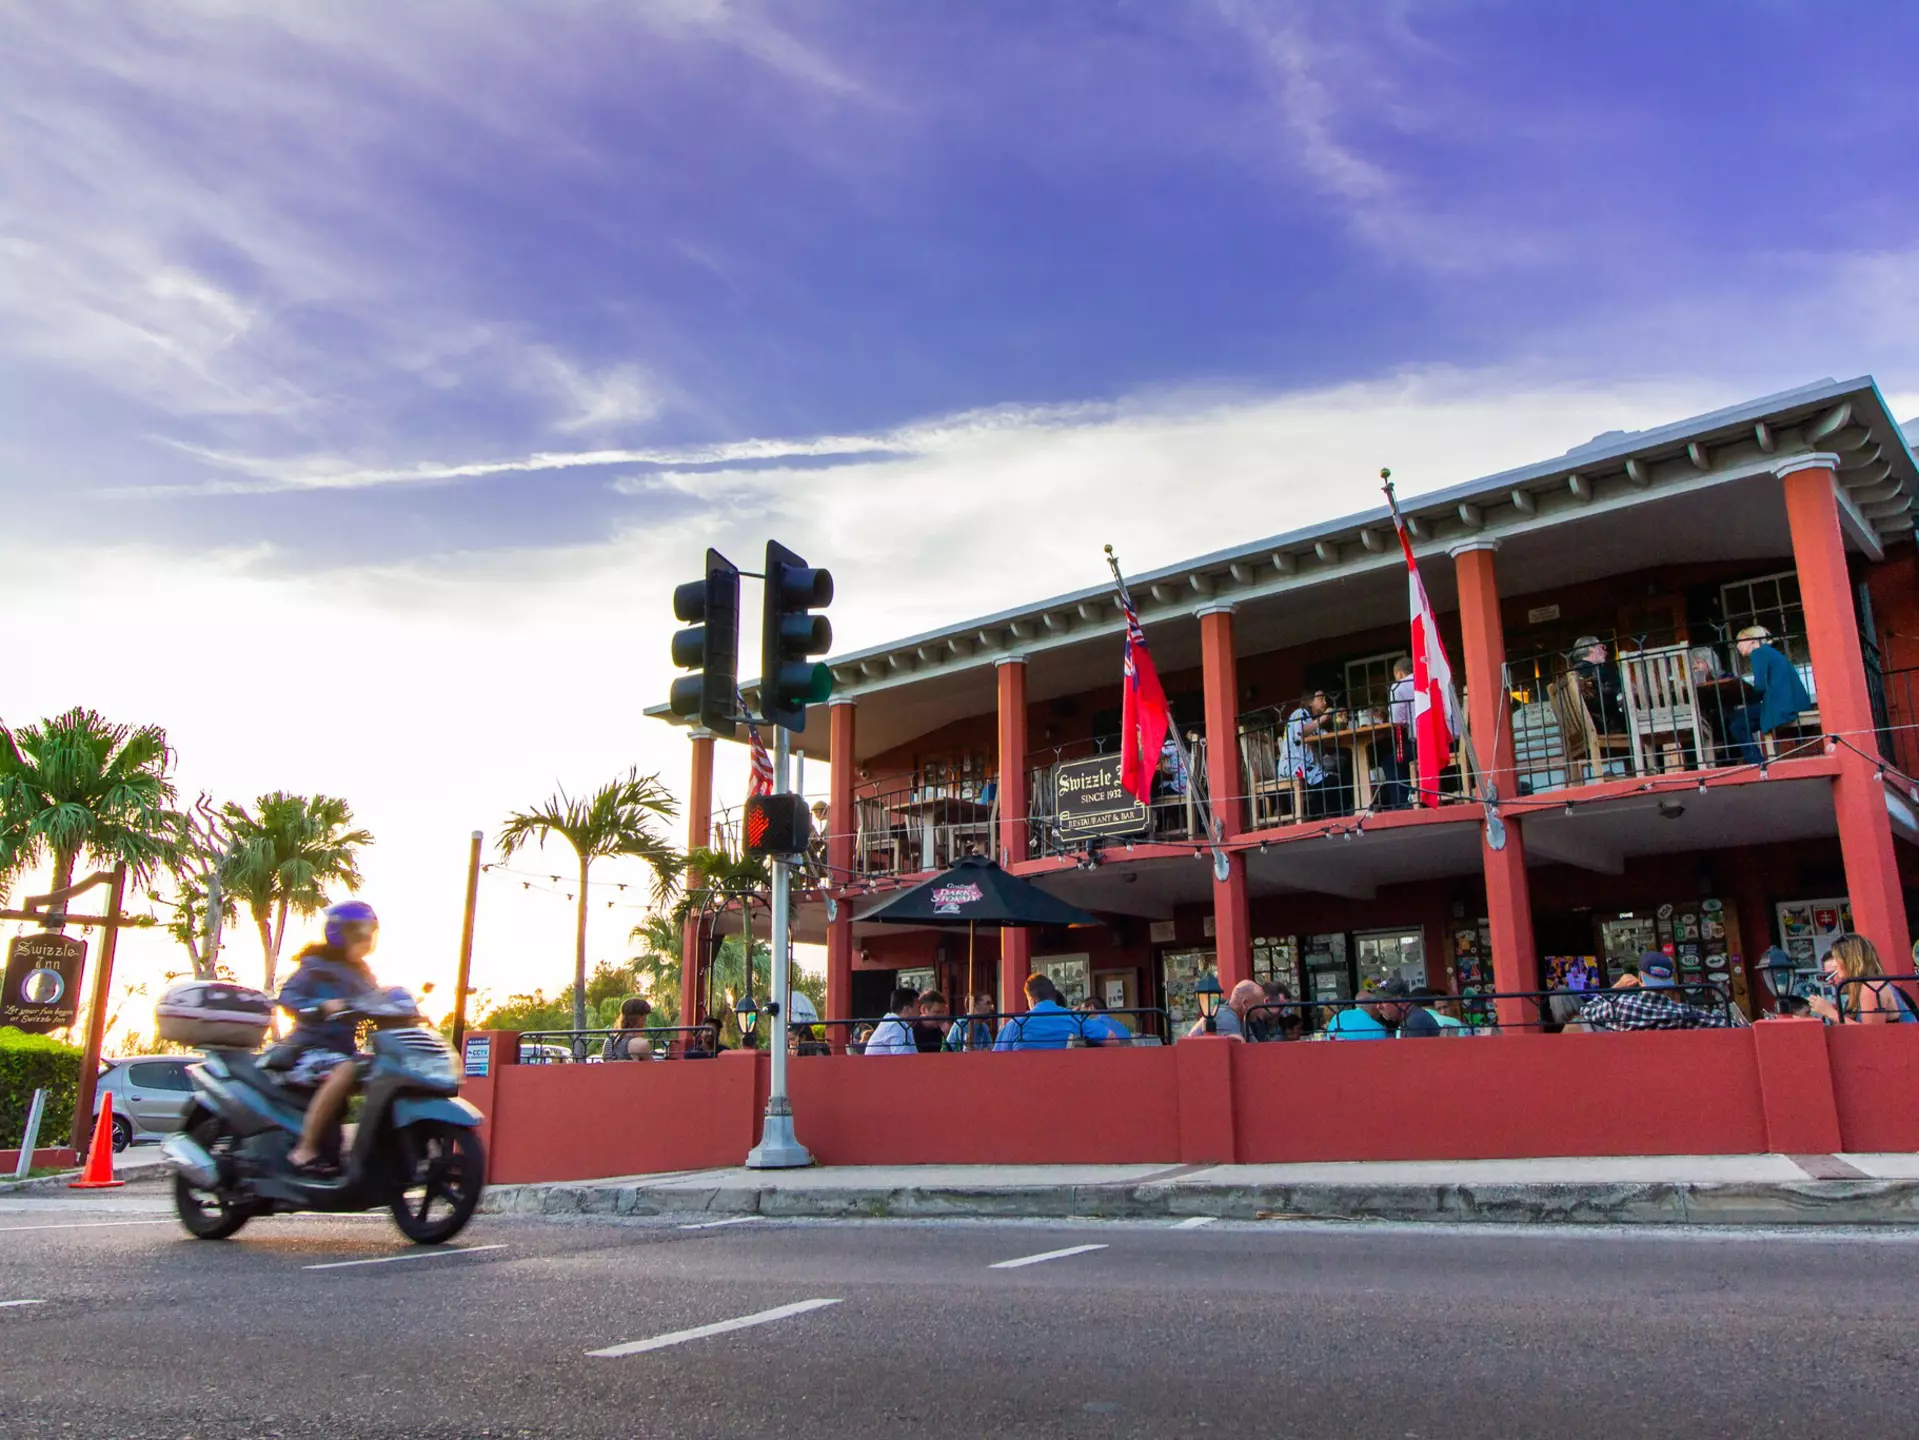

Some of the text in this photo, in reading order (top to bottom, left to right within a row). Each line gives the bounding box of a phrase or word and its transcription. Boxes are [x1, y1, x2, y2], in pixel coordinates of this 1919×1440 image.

[1059, 769, 1111, 796] Swizzle
[1081, 788, 1122, 804] SINCE 1932
[1068, 815, 1112, 828] RESTAURANT
[1121, 811, 1136, 820] BAR
[14, 941, 79, 957] Swizzle
[35, 957, 60, 970] Inn
[19, 1008, 40, 1016] your
[40, 1007, 53, 1015] fun
[54, 1008, 73, 1016] begin
[20, 1015, 51, 1023] Swizzle
